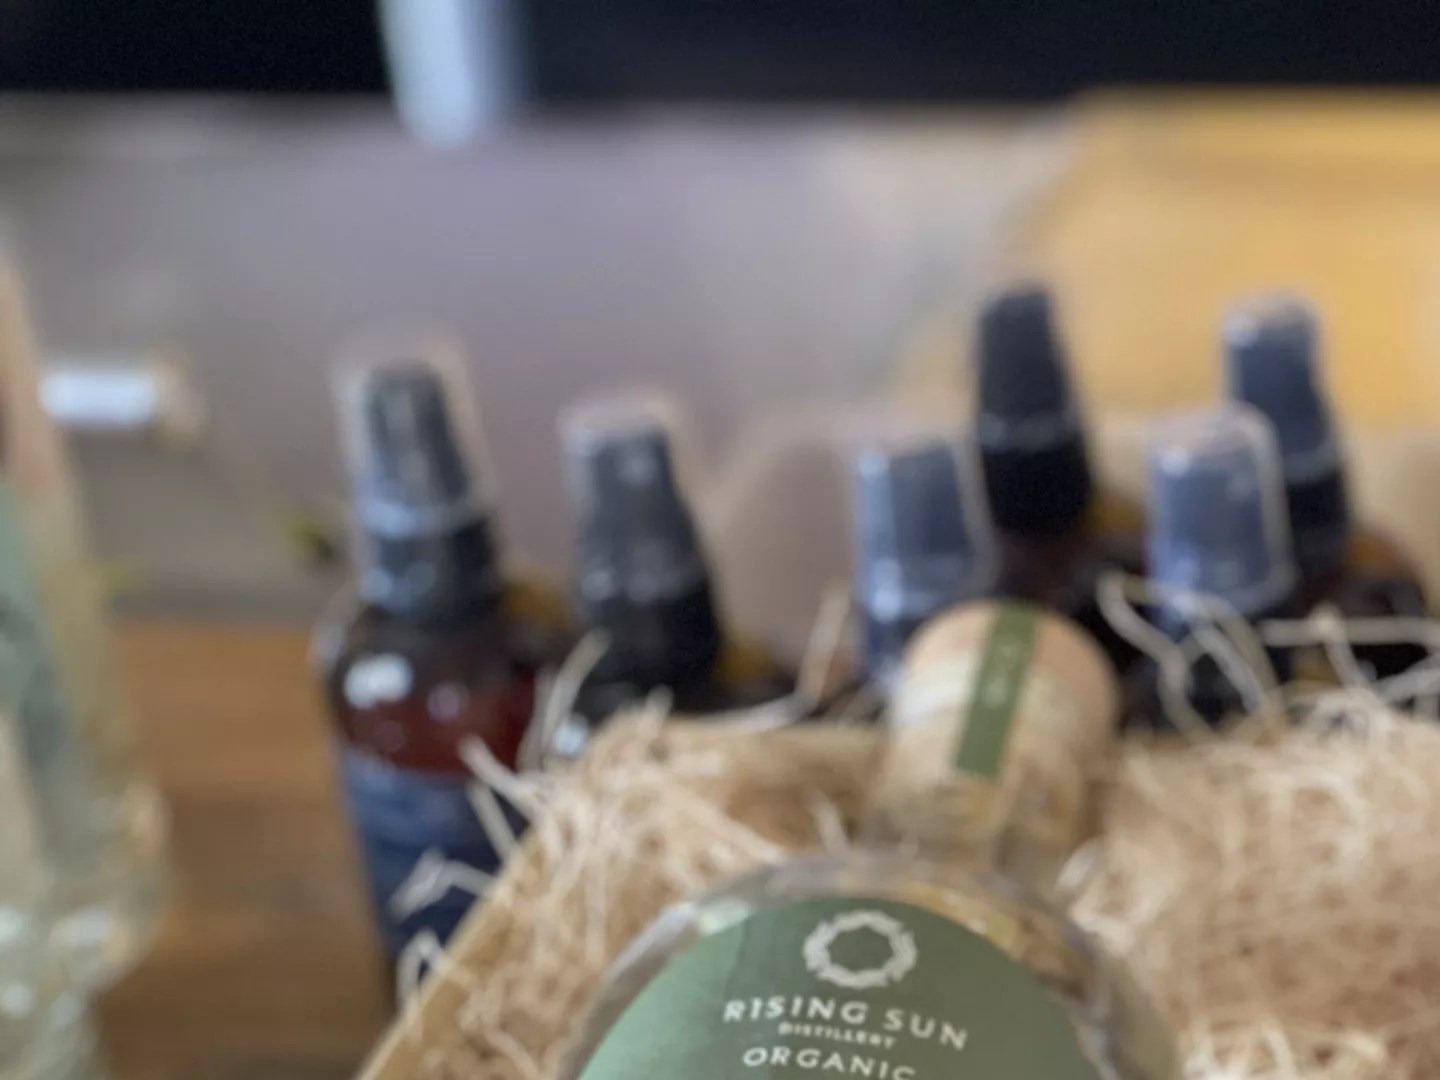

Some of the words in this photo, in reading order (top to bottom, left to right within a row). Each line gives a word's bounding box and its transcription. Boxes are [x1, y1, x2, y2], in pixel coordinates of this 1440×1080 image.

[723, 996, 869, 1023] RISING
[883, 1008, 968, 1050] SUN
[778, 1021, 897, 1049] DISTILLERY
